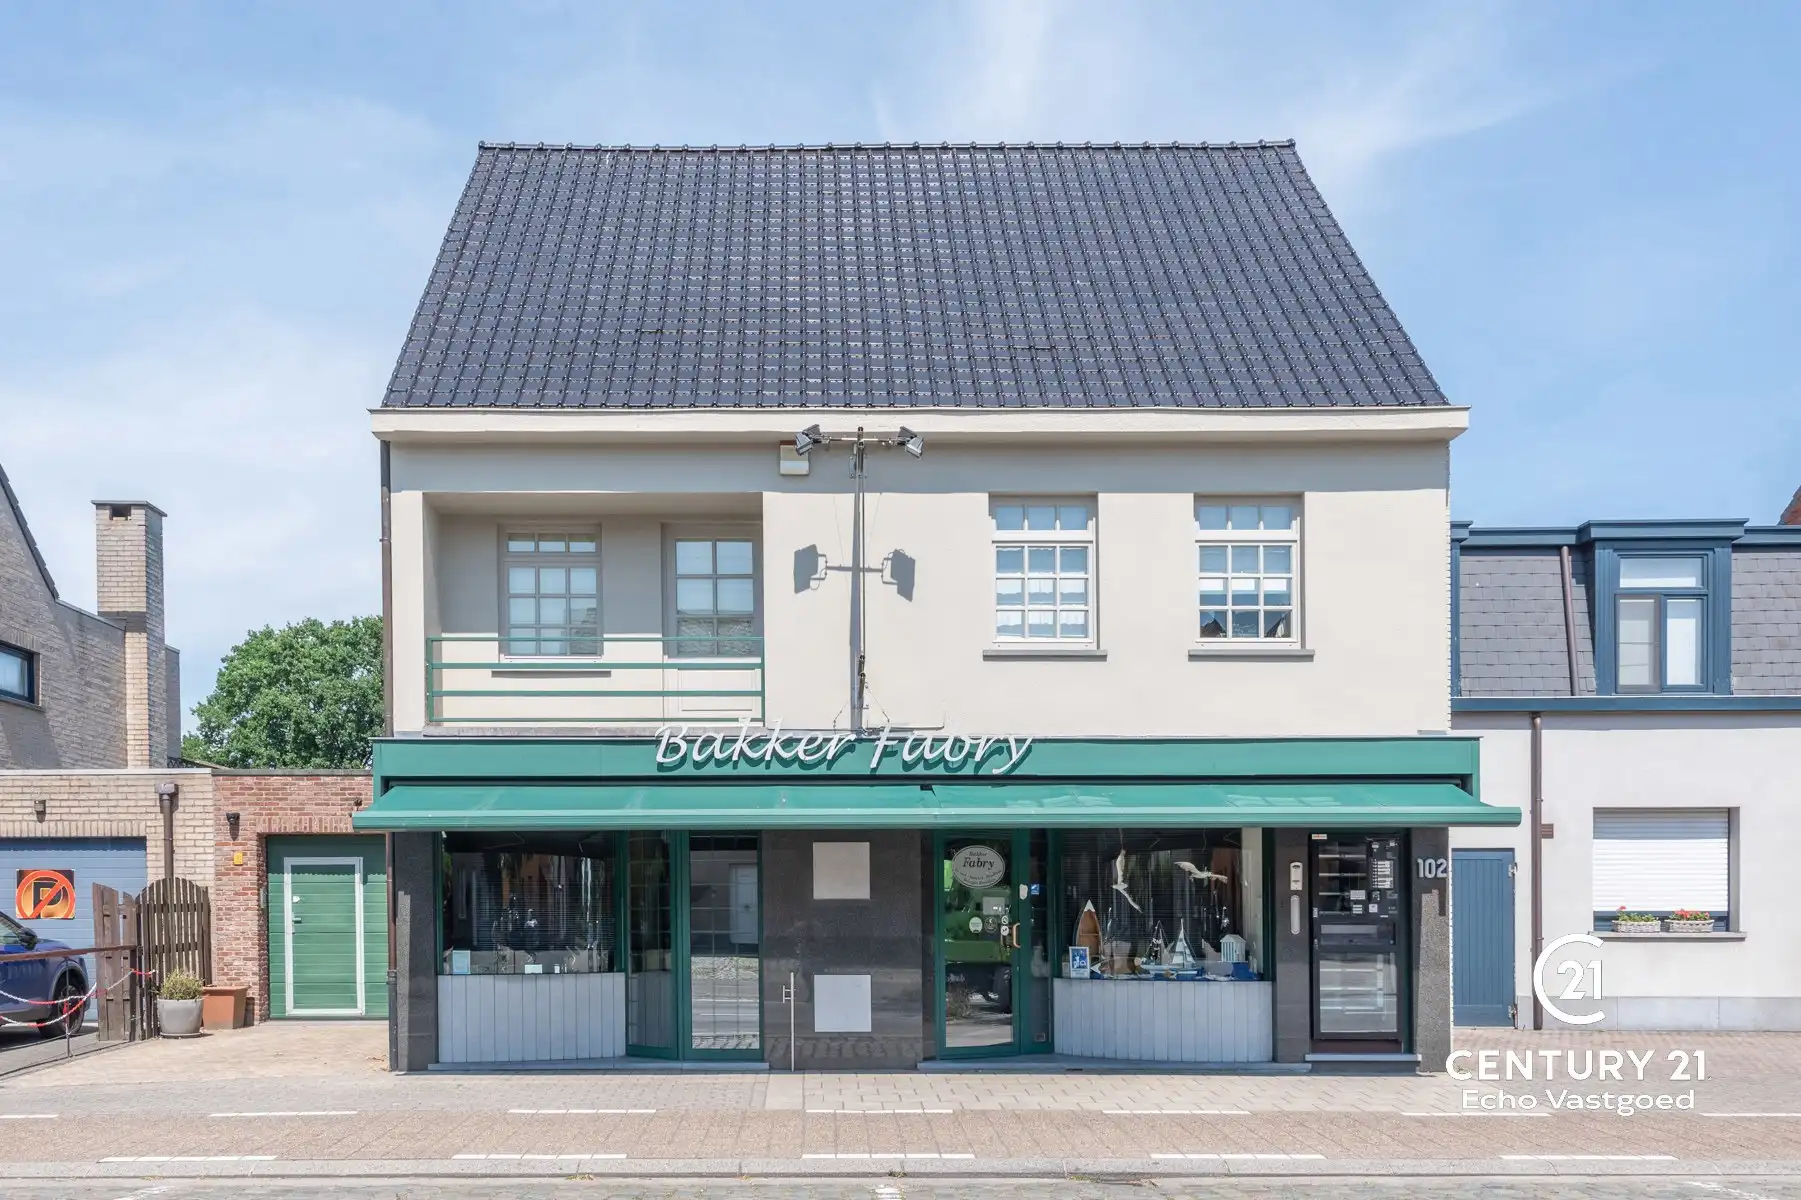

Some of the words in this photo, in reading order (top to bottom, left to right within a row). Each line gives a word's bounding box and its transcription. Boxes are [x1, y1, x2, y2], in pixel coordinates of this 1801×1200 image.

[655, 717, 857, 763] Bakker
[962, 857, 995, 871] Fabry
[1417, 858, 1447, 878] 102
